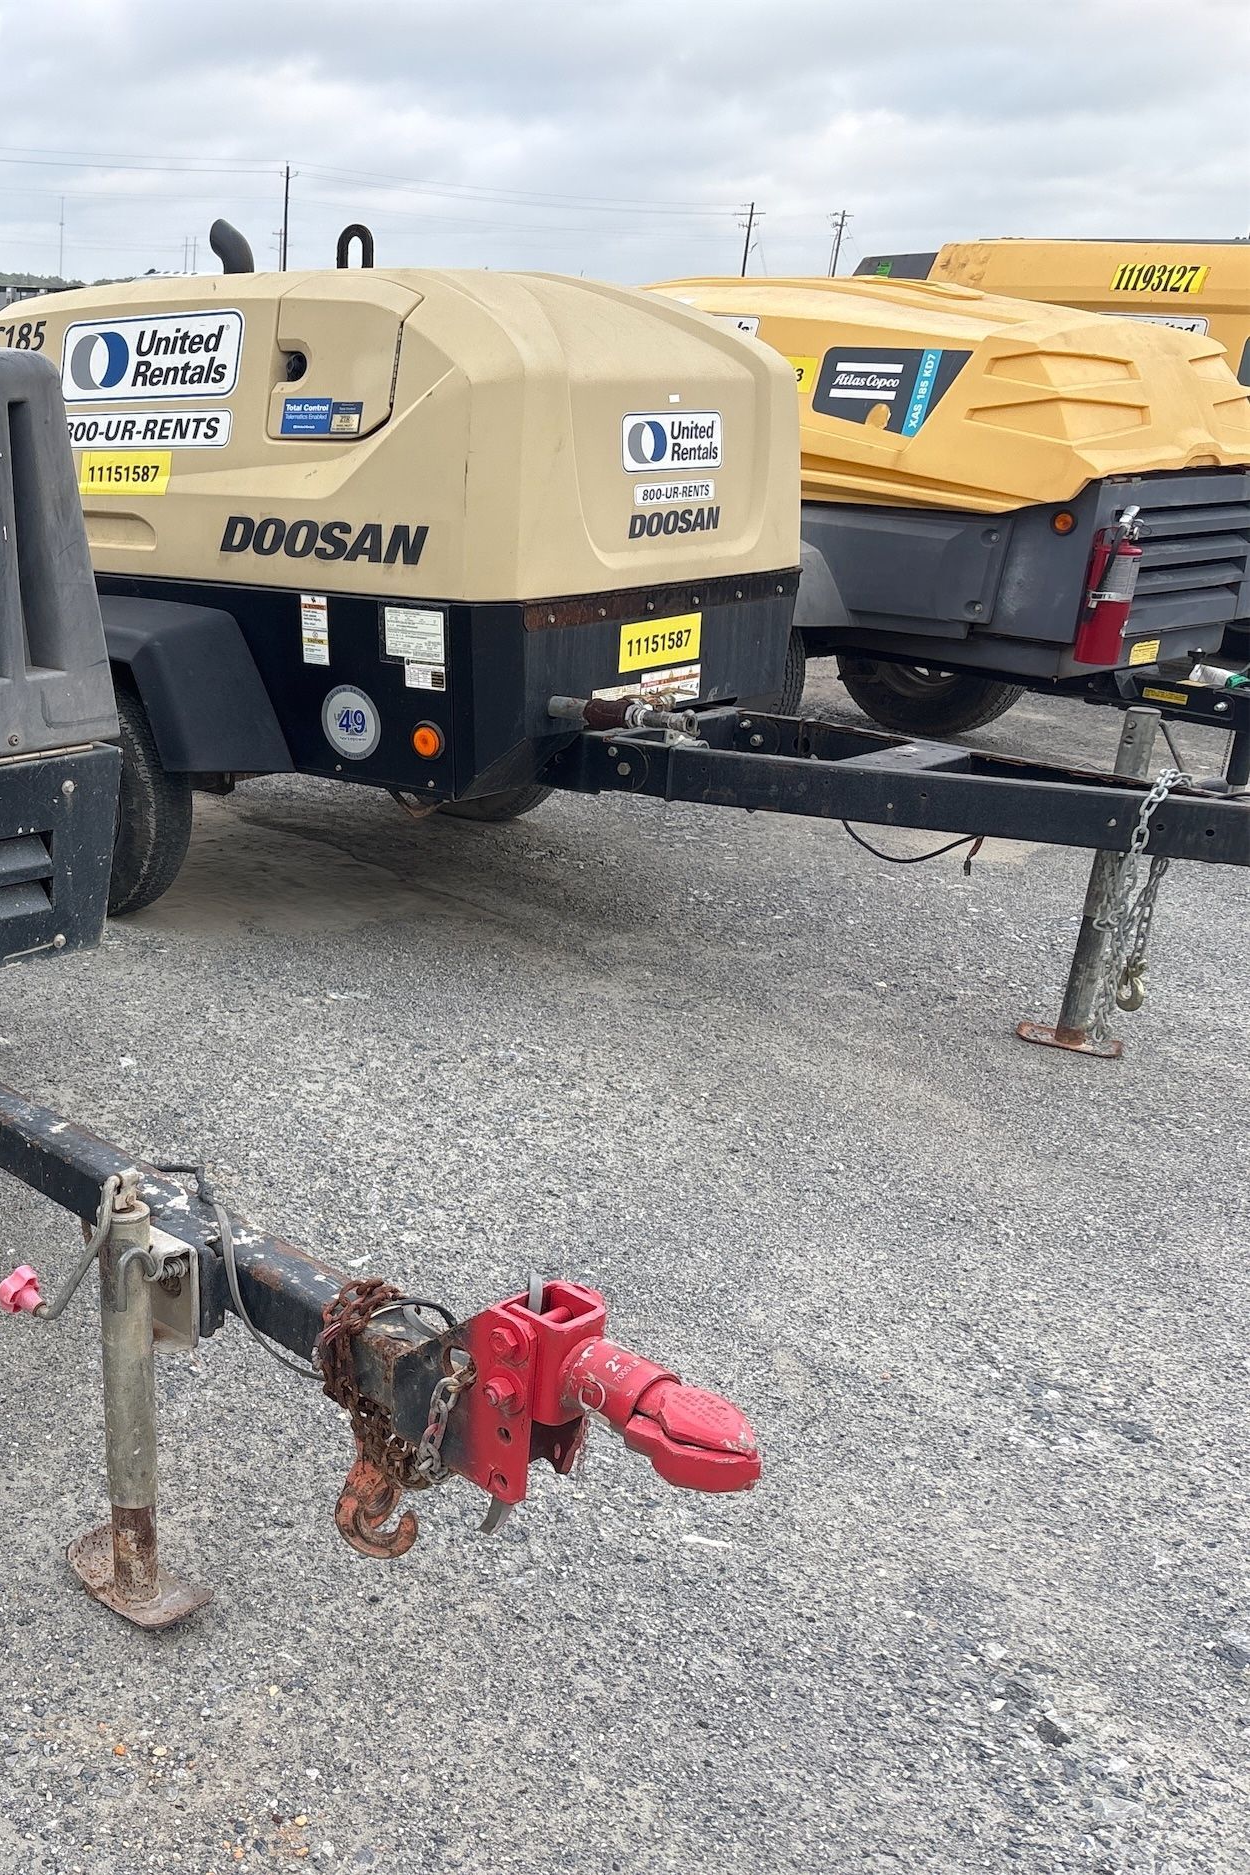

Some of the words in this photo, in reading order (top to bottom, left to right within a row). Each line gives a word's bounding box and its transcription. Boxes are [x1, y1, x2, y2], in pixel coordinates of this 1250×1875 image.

[1114, 264, 1200, 292] 11193127
[135, 325, 225, 356] United
[131, 357, 227, 387] Rentals
[832, 373, 867, 386] Atlas
[866, 375, 900, 389] Copco
[908, 404, 923, 428] XAS
[917, 380, 929, 400] 185
[923, 354, 936, 377] KD7
[670, 420, 714, 440] United
[671, 441, 718, 461] Rentals
[88, 465, 159, 483] 11151587
[642, 484, 710, 501] 800-UR-RENTS
[628, 506, 720, 539] DOOSAN
[219, 516, 429, 565] DOOSAN
[627, 629, 691, 657] 11151587
[338, 709, 366, 734] 49
[613, 1365, 632, 1384] 7000
